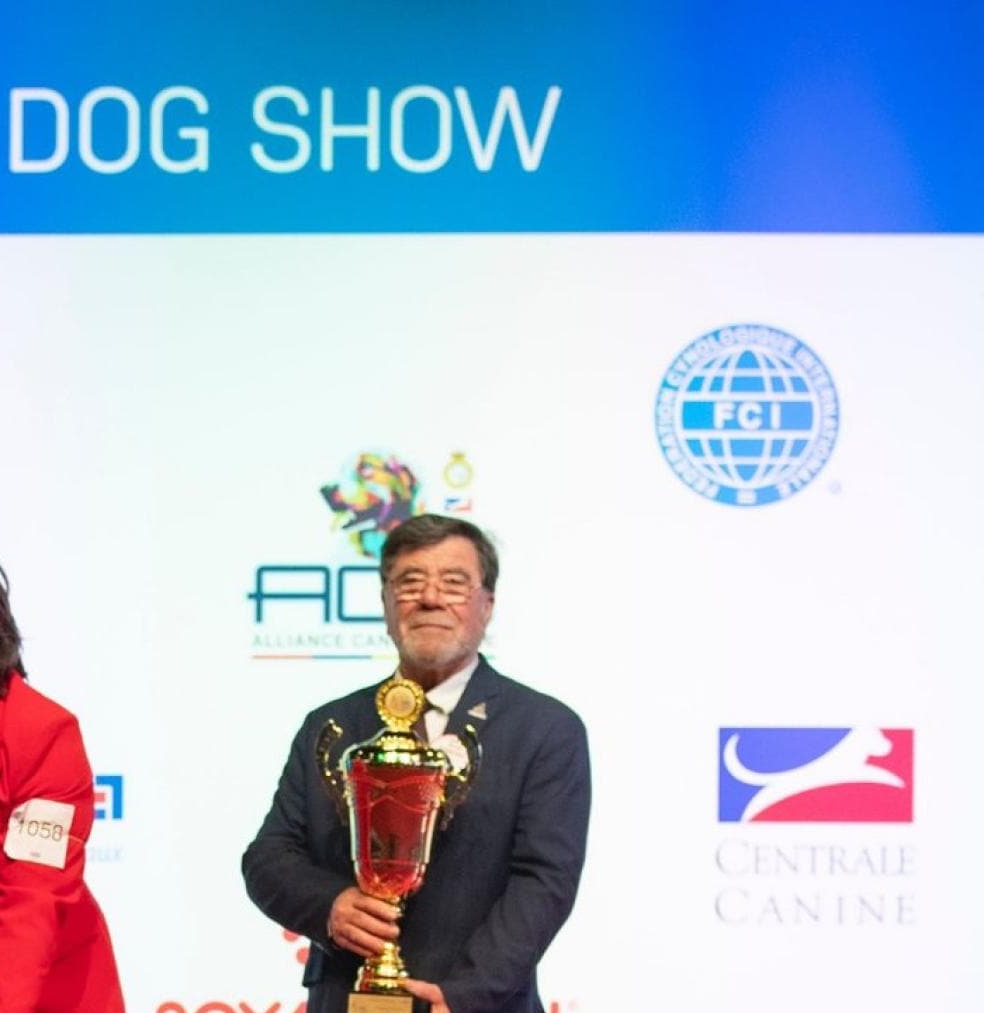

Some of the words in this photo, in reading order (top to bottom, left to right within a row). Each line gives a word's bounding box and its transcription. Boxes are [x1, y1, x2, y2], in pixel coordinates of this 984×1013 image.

[8, 84, 210, 175] DOG
[250, 84, 563, 174] SHOW
[713, 402, 782, 430] FCI
[247, 565, 384, 624] AC
[252, 634, 344, 648] ALLIANCE
[352, 634, 391, 648] CAN
[18, 819, 64, 842] 1058
[715, 837, 915, 875] CENTRALE
[714, 887, 915, 925] CANINE
